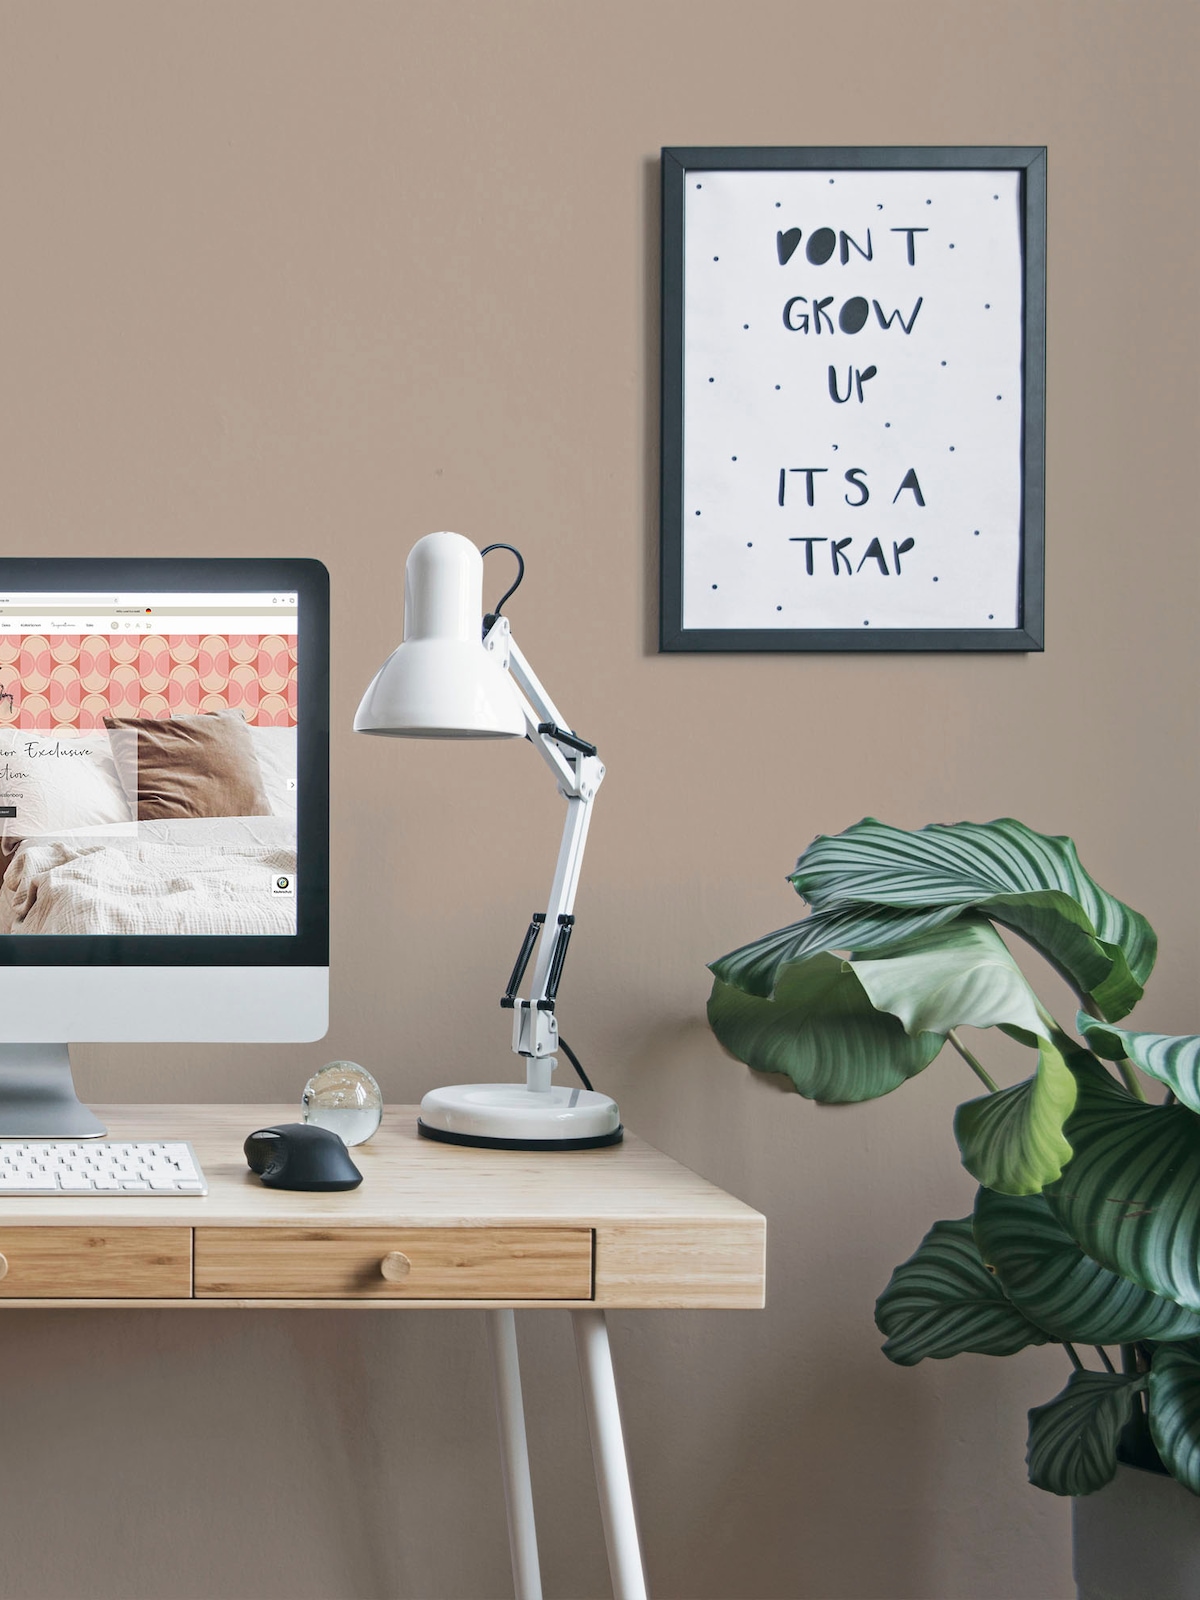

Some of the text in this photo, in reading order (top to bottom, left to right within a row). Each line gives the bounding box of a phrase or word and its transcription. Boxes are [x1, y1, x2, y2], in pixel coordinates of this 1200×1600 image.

[776, 204, 929, 267] DON'T
[782, 296, 924, 335] GROW
[828, 364, 878, 404] UP
[778, 444, 926, 507] IT'S A
[788, 536, 915, 576] TRAP
[23, 741, 94, 759] Exclusive
